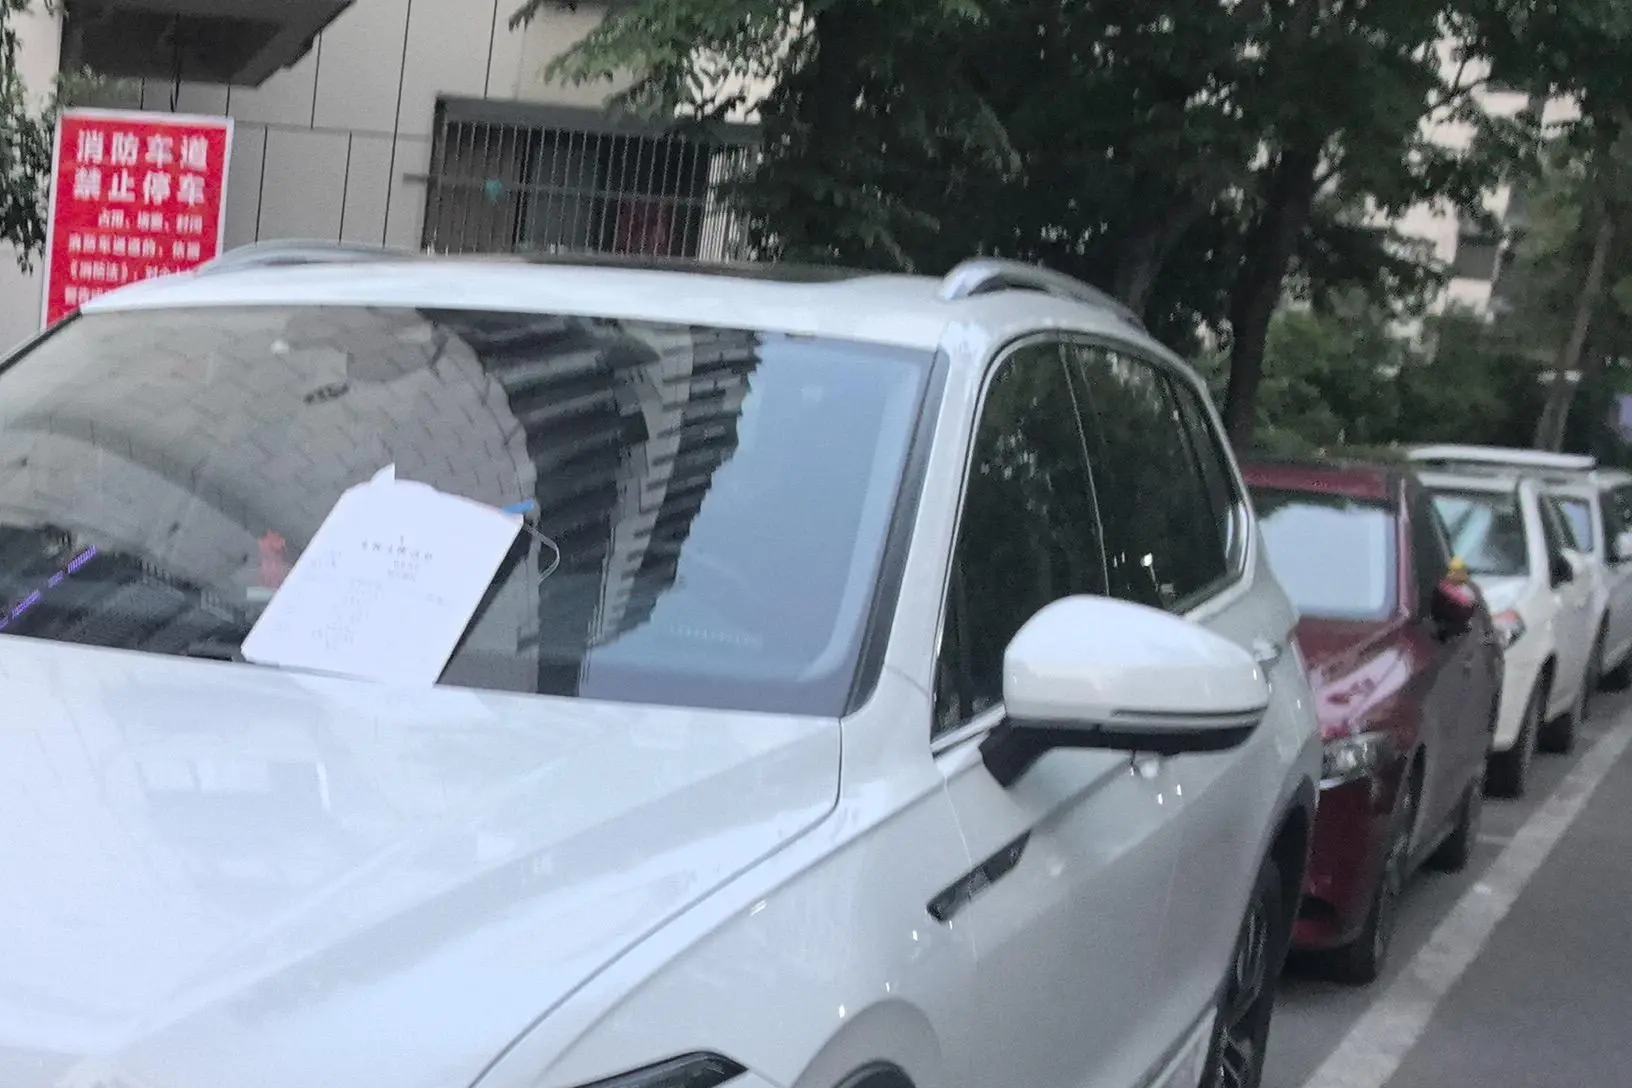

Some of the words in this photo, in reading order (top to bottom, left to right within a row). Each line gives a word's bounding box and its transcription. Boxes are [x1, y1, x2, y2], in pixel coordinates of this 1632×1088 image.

[77, 129, 208, 171] 消防车道
[74, 165, 206, 207] 禁止停车
